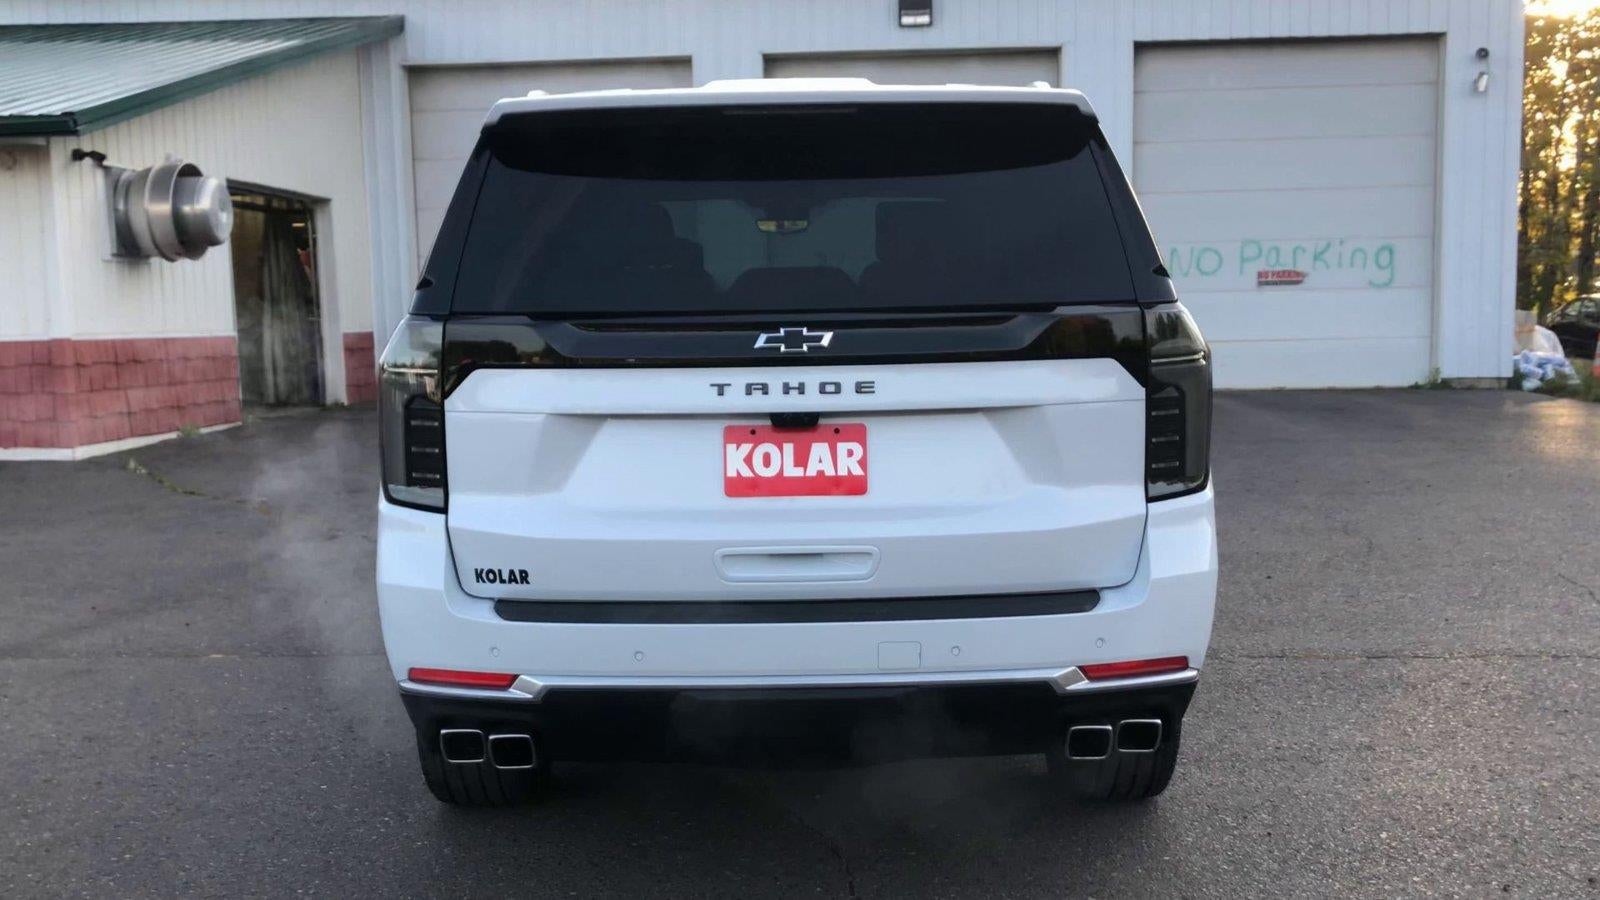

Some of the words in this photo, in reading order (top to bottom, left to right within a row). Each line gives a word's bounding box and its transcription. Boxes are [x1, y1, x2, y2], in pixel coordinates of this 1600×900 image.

[1168, 246, 1223, 277] NO
[709, 381, 876, 397] TAHOE
[725, 442, 865, 478] KOLAR
[474, 568, 530, 585] KOLAR
